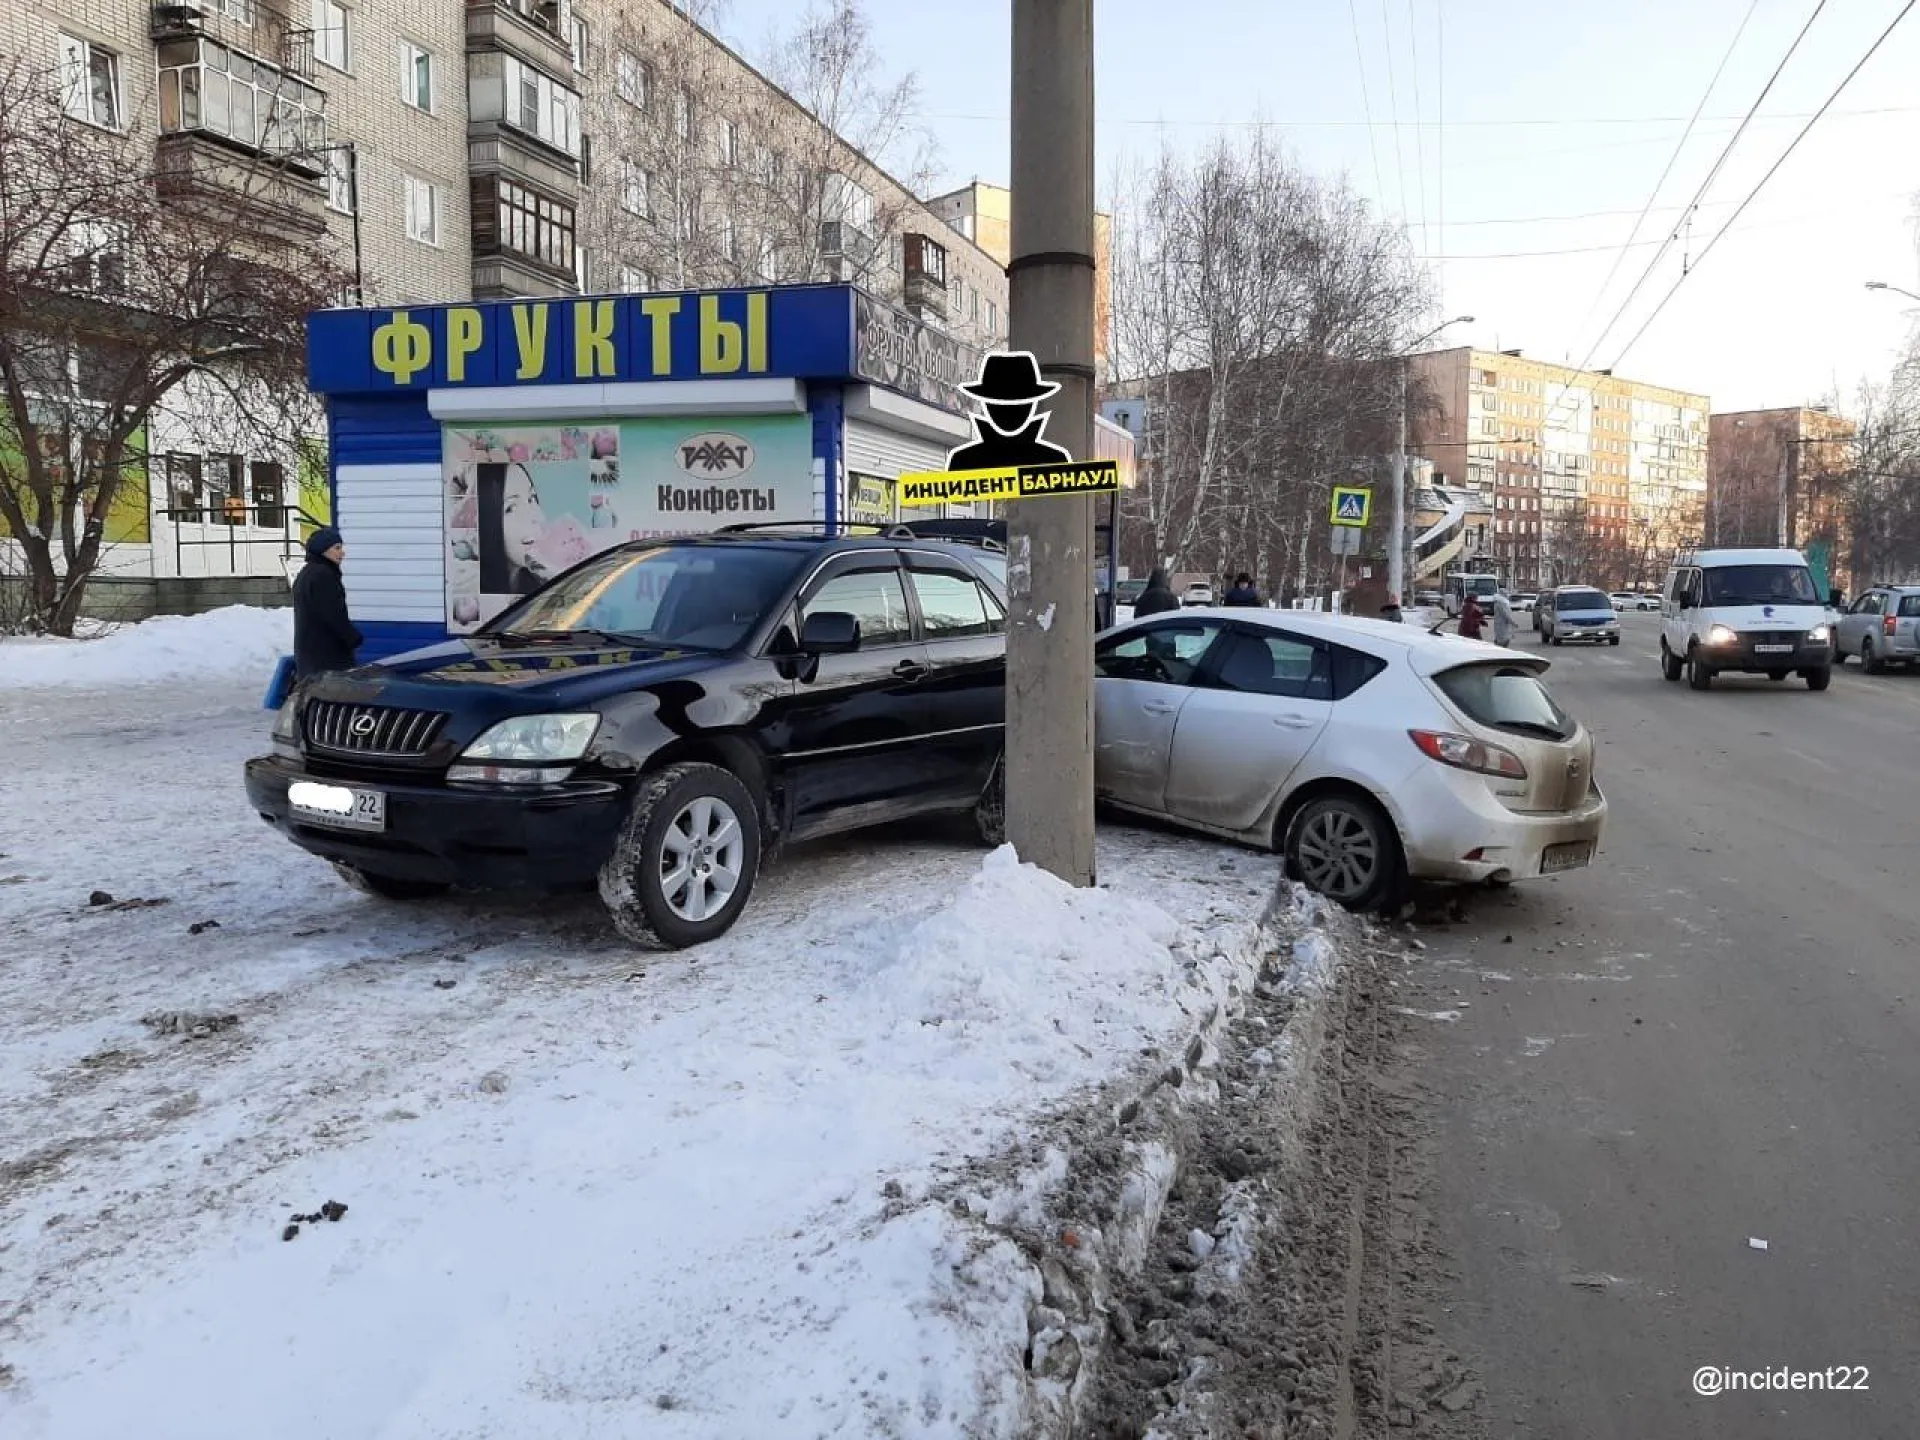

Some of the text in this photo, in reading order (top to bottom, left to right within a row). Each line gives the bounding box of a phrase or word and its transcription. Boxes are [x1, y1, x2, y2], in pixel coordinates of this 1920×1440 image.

[372, 293, 767, 385] ФРУКТЫ
[657, 484, 775, 514] Конфеты
[359, 795, 376, 813] 22
